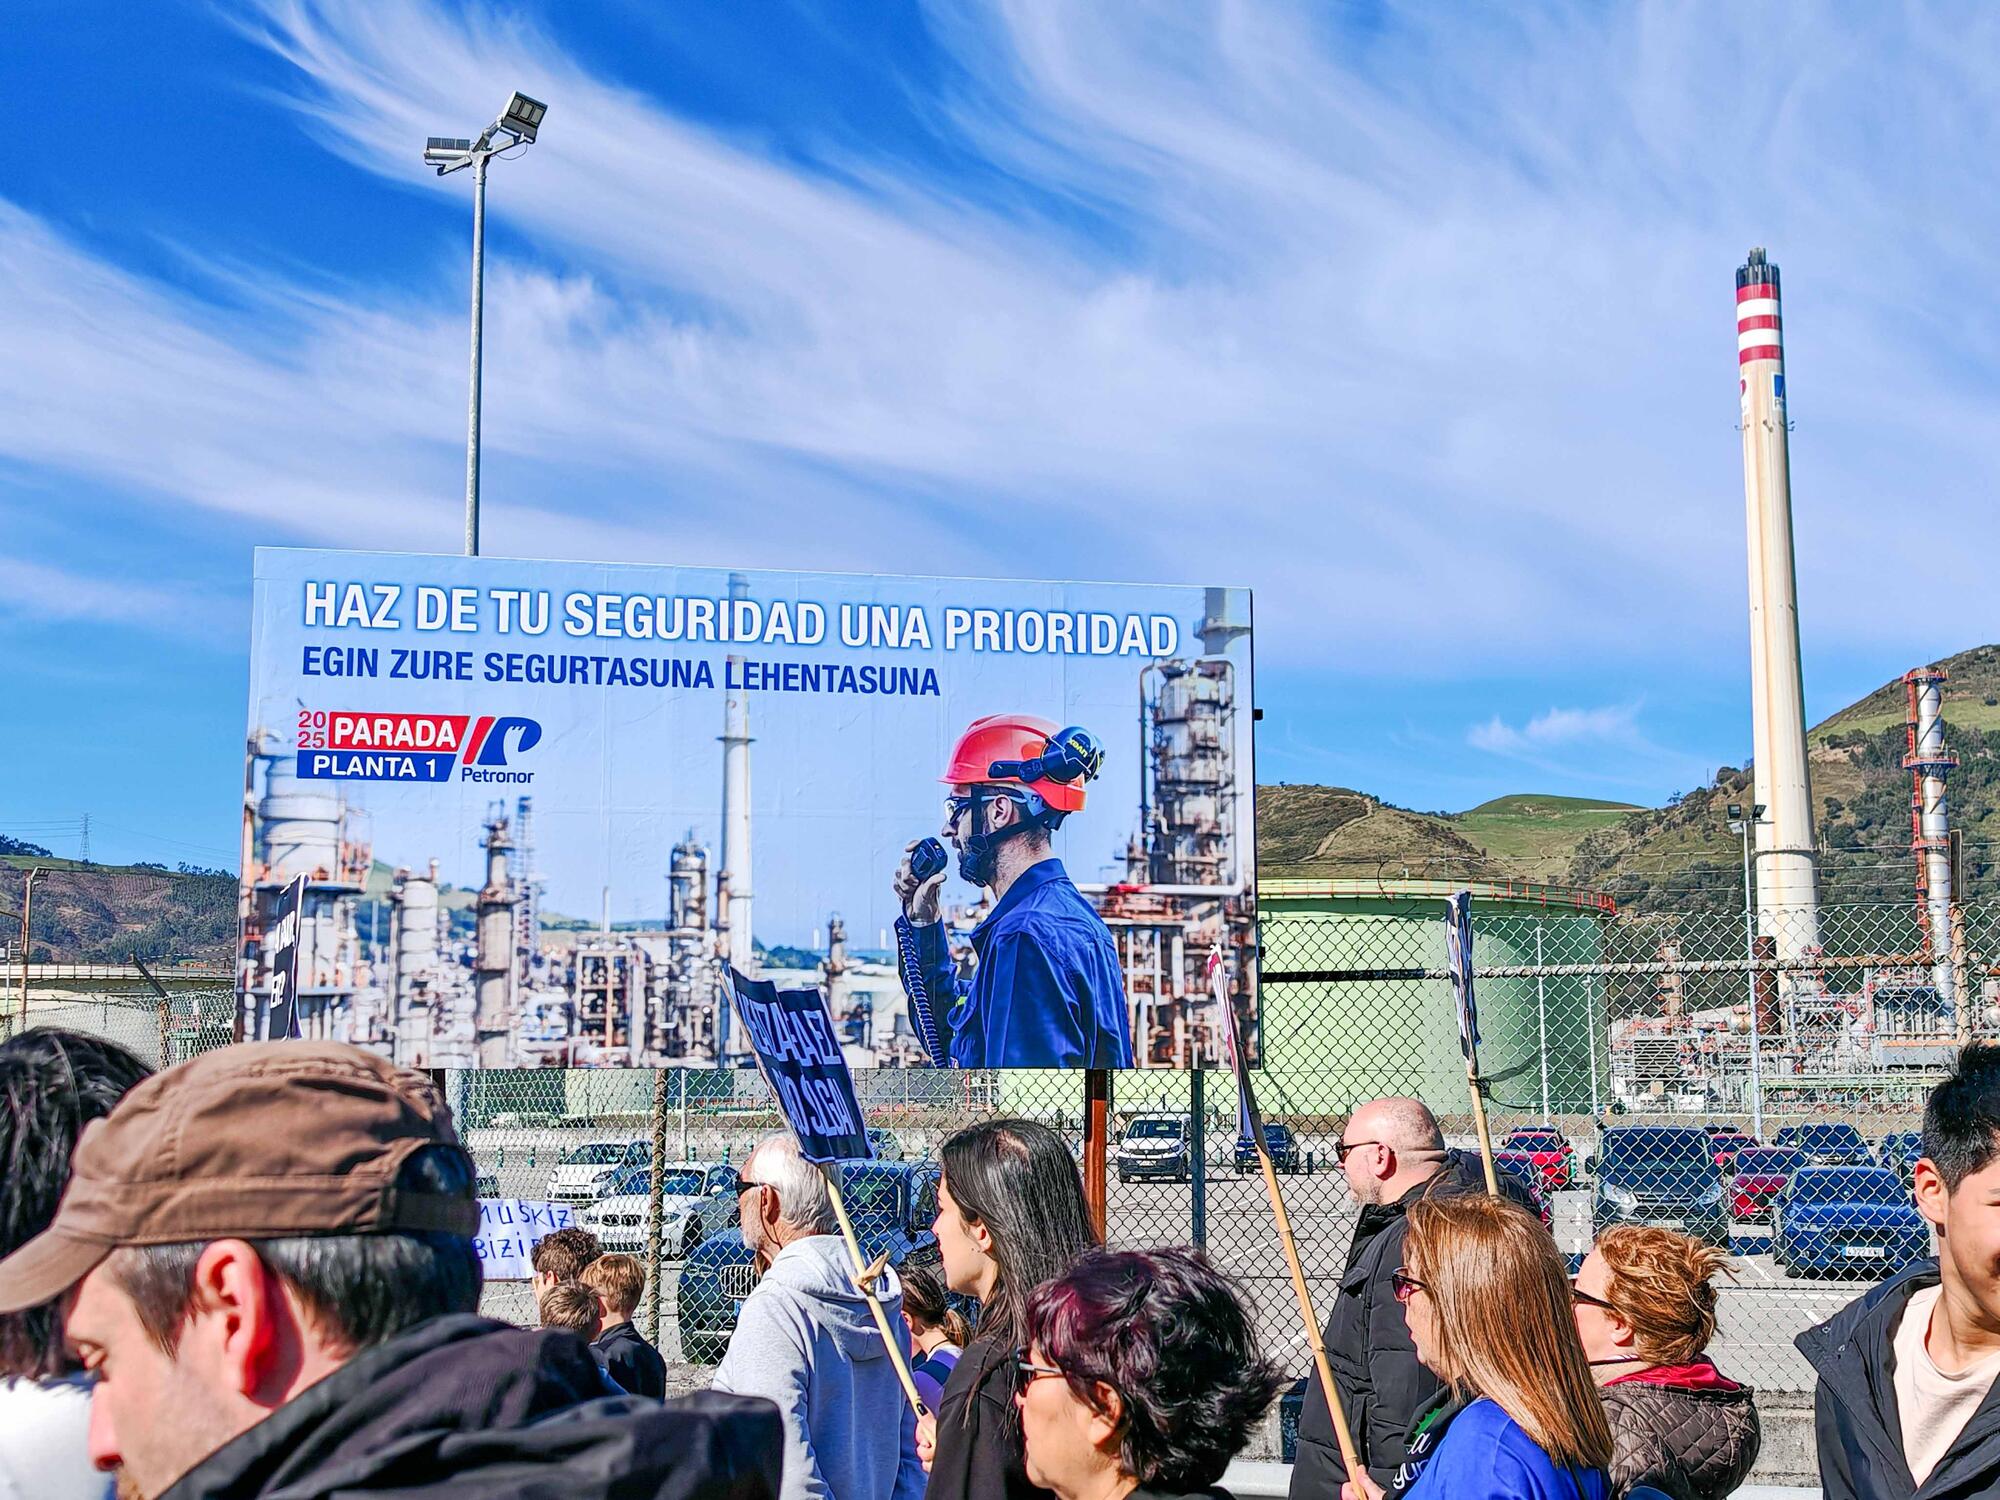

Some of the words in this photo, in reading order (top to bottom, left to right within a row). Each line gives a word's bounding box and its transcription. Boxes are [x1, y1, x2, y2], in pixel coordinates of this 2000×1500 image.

[304, 582, 401, 629] HAZ
[416, 587, 478, 633] DE
[490, 590, 549, 636] TU
[564, 593, 825, 645] SEGURIDAD
[840, 605, 931, 650] UNA
[945, 608, 1178, 657] PRIORIDAD
[302, 646, 378, 678] EGIN
[390, 649, 473, 681] ZURE
[484, 652, 715, 690] SEGURTASUNA
[725, 661, 940, 697] LEHENTASUNA
[298, 711, 326, 728] 20
[298, 731, 325, 749] 25
[334, 717, 457, 748] PARADA
[313, 755, 417, 778] PLANTA
[425, 759, 436, 778] 1
[462, 767, 534, 784] Petronor
